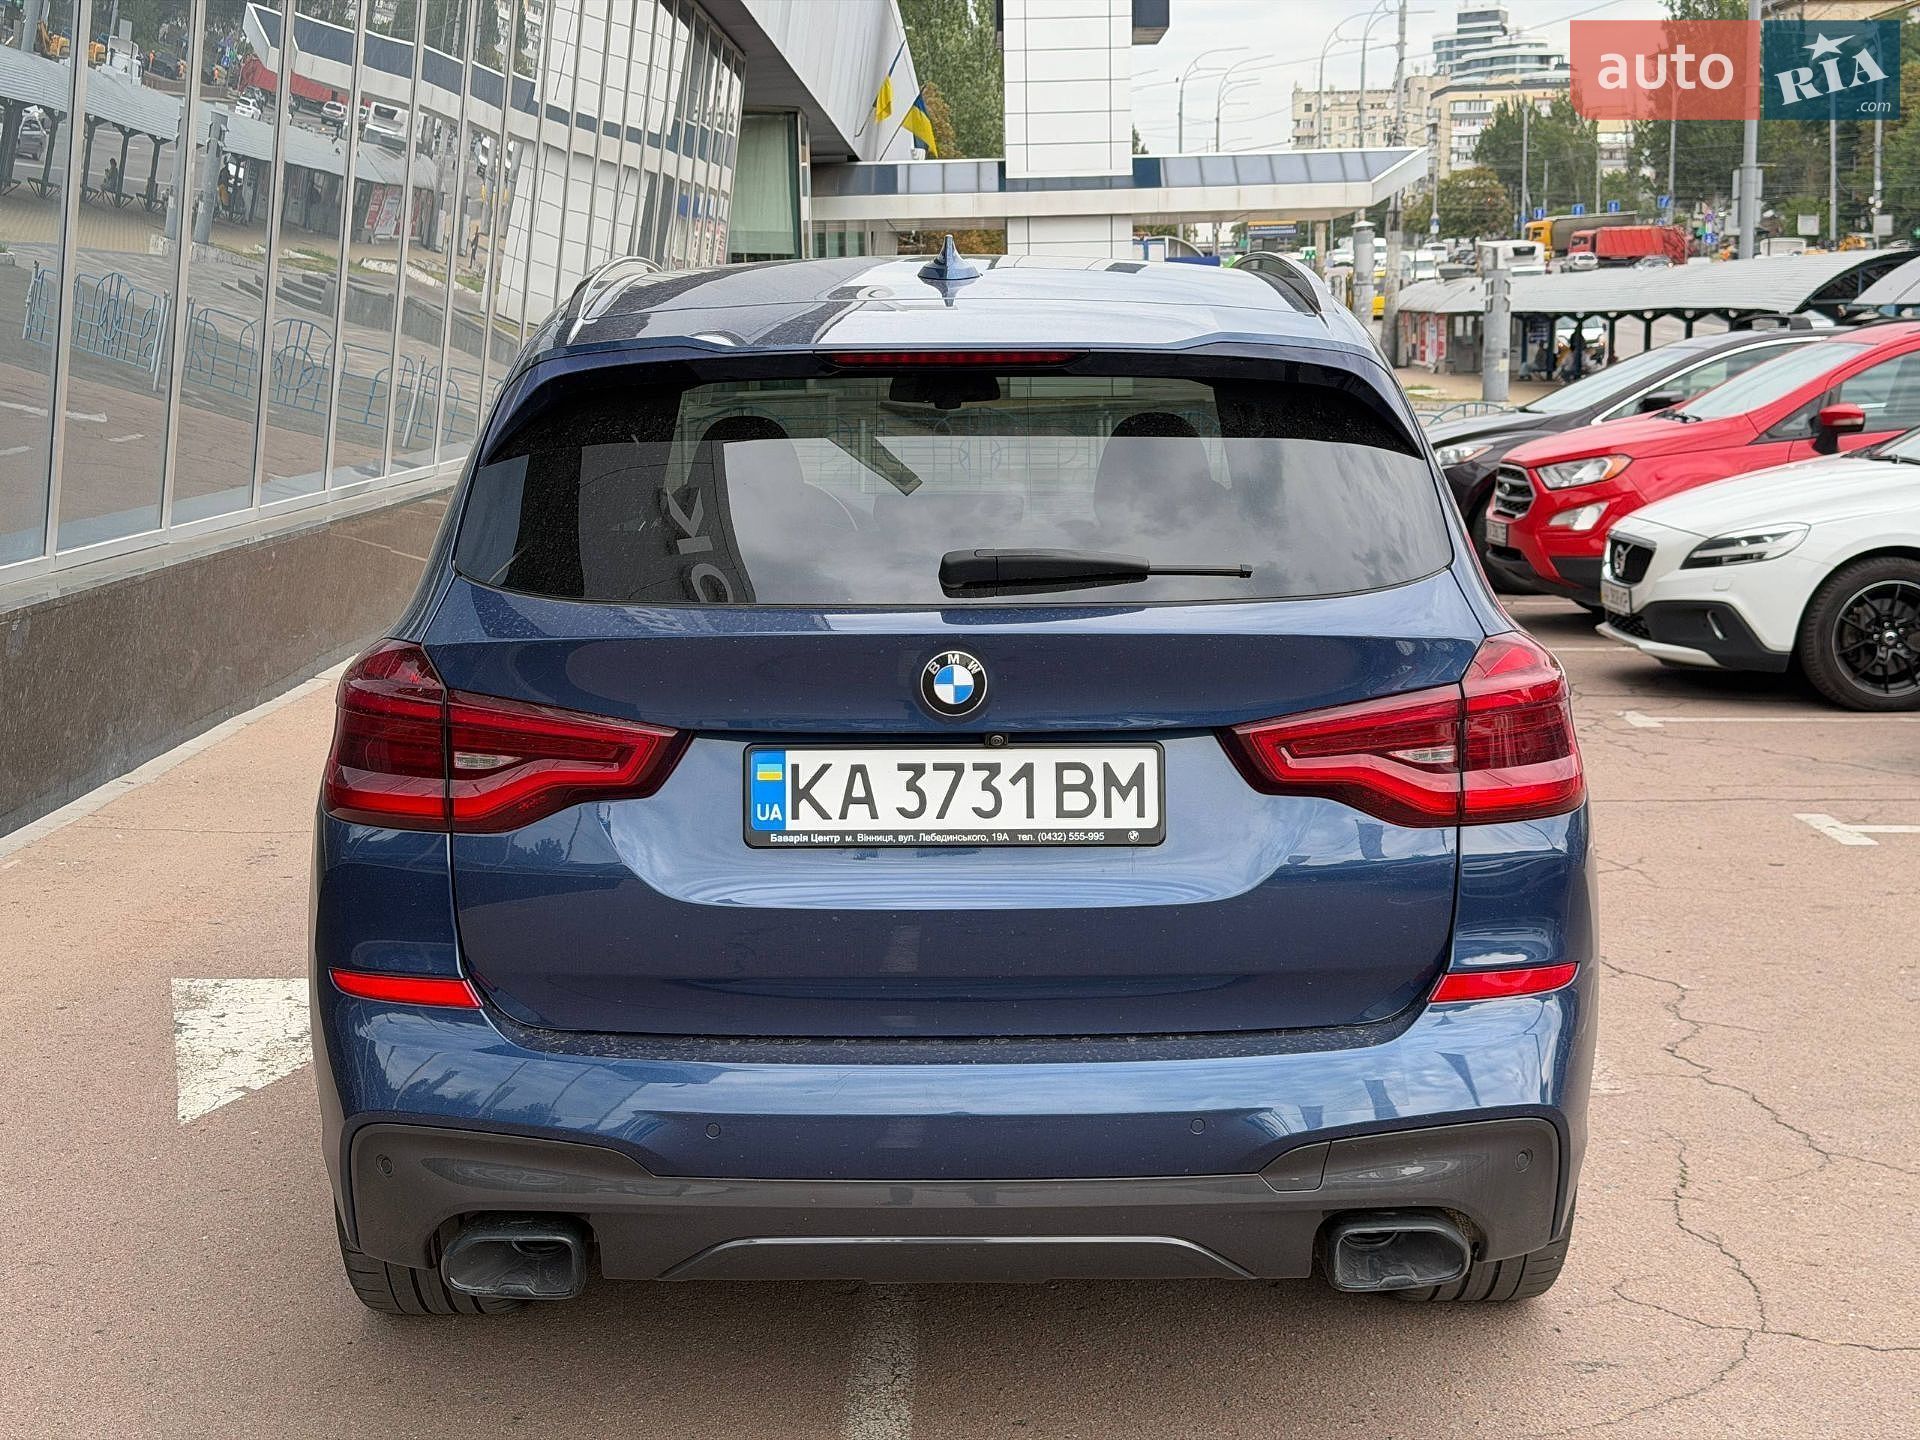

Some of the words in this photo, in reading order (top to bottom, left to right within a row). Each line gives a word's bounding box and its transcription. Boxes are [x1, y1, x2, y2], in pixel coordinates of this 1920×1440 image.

[928, 653, 981, 676] BMW
[791, 763, 879, 820] KA
[896, 762, 1035, 819] 3731
[1055, 761, 1146, 819] BM
[757, 804, 783, 821] UA
[770, 833, 809, 845] Баварія
[811, 833, 841, 845] Центр
[857, 833, 896, 844] Вінниця,
[898, 834, 916, 844] вул.
[918, 832, 989, 843] Лебединського,
[1017, 833, 1036, 842] тел.
[1038, 832, 1067, 843] (0432)
[1068, 831, 1105, 842] 555-995
